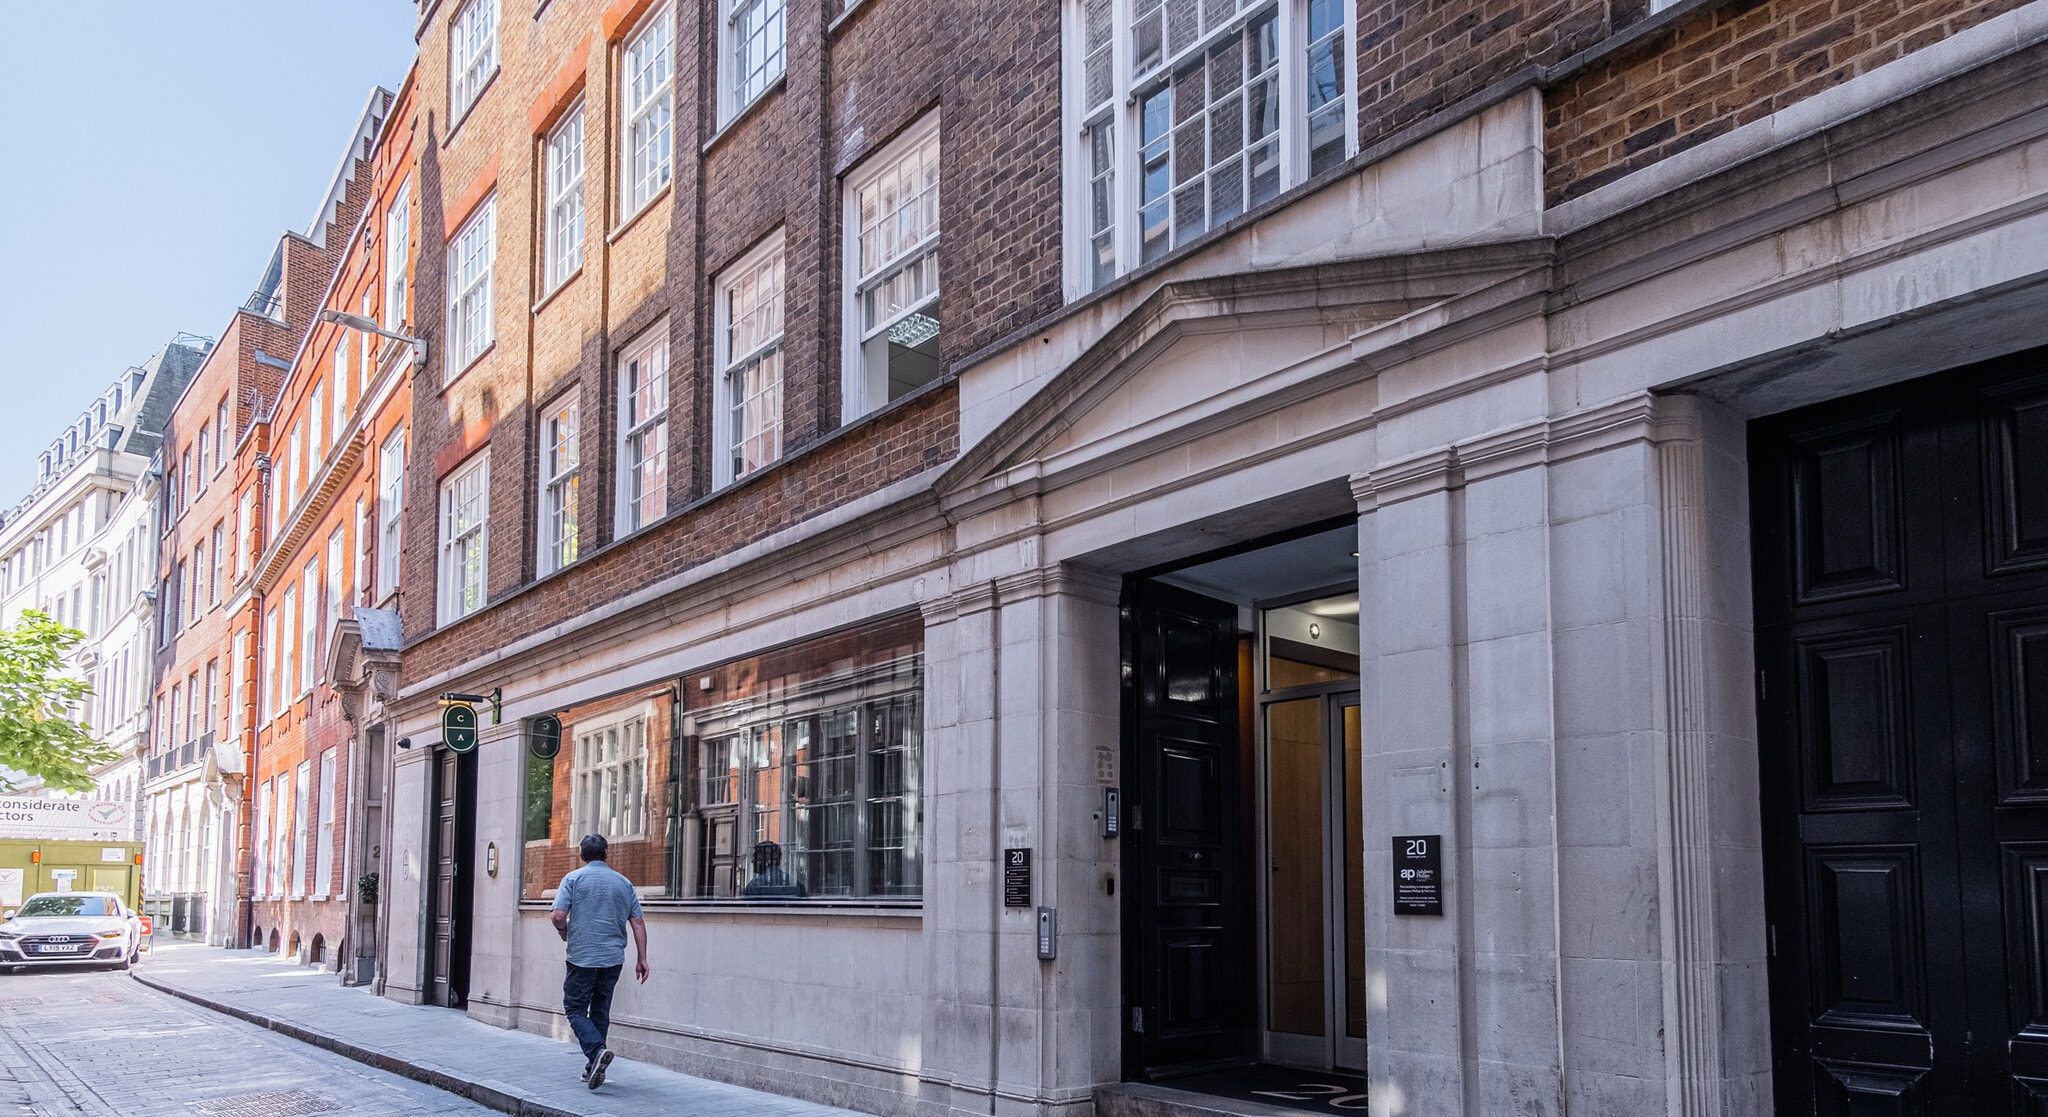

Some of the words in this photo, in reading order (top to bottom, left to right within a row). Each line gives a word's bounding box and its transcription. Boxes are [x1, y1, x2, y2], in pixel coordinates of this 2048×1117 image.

[457, 715, 464, 723] C
[0, 800, 80, 812] onsiderate
[1406, 839, 1427, 855] 20
[1012, 851, 1024, 863] 20
[1400, 869, 1415, 880] ap
